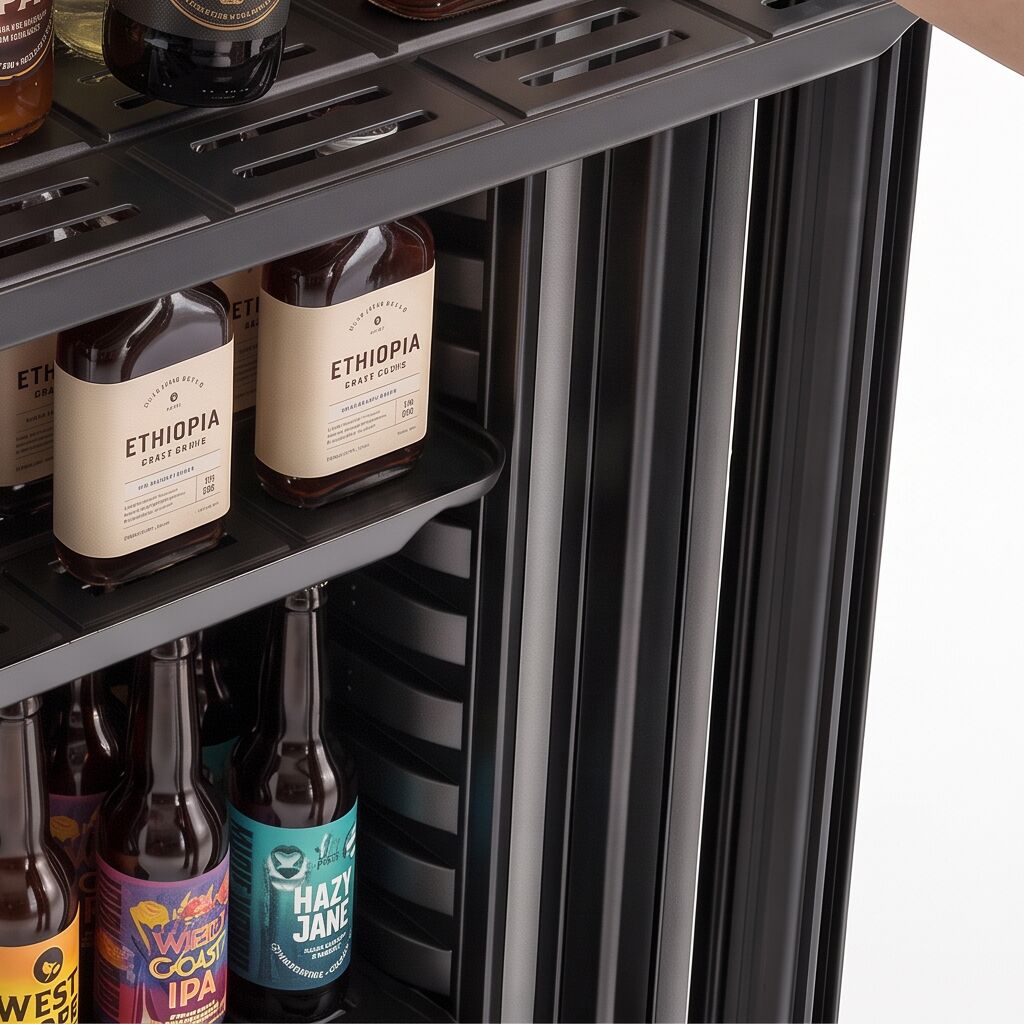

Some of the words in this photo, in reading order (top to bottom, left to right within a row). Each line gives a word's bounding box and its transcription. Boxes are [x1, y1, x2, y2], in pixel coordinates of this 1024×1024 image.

[330, 332, 421, 381] ETHIOPIA
[125, 408, 220, 459] ETHIOPIA
[293, 865, 352, 914] HAZY
[292, 897, 349, 943] JANE
[168, 969, 217, 1009] IPA
